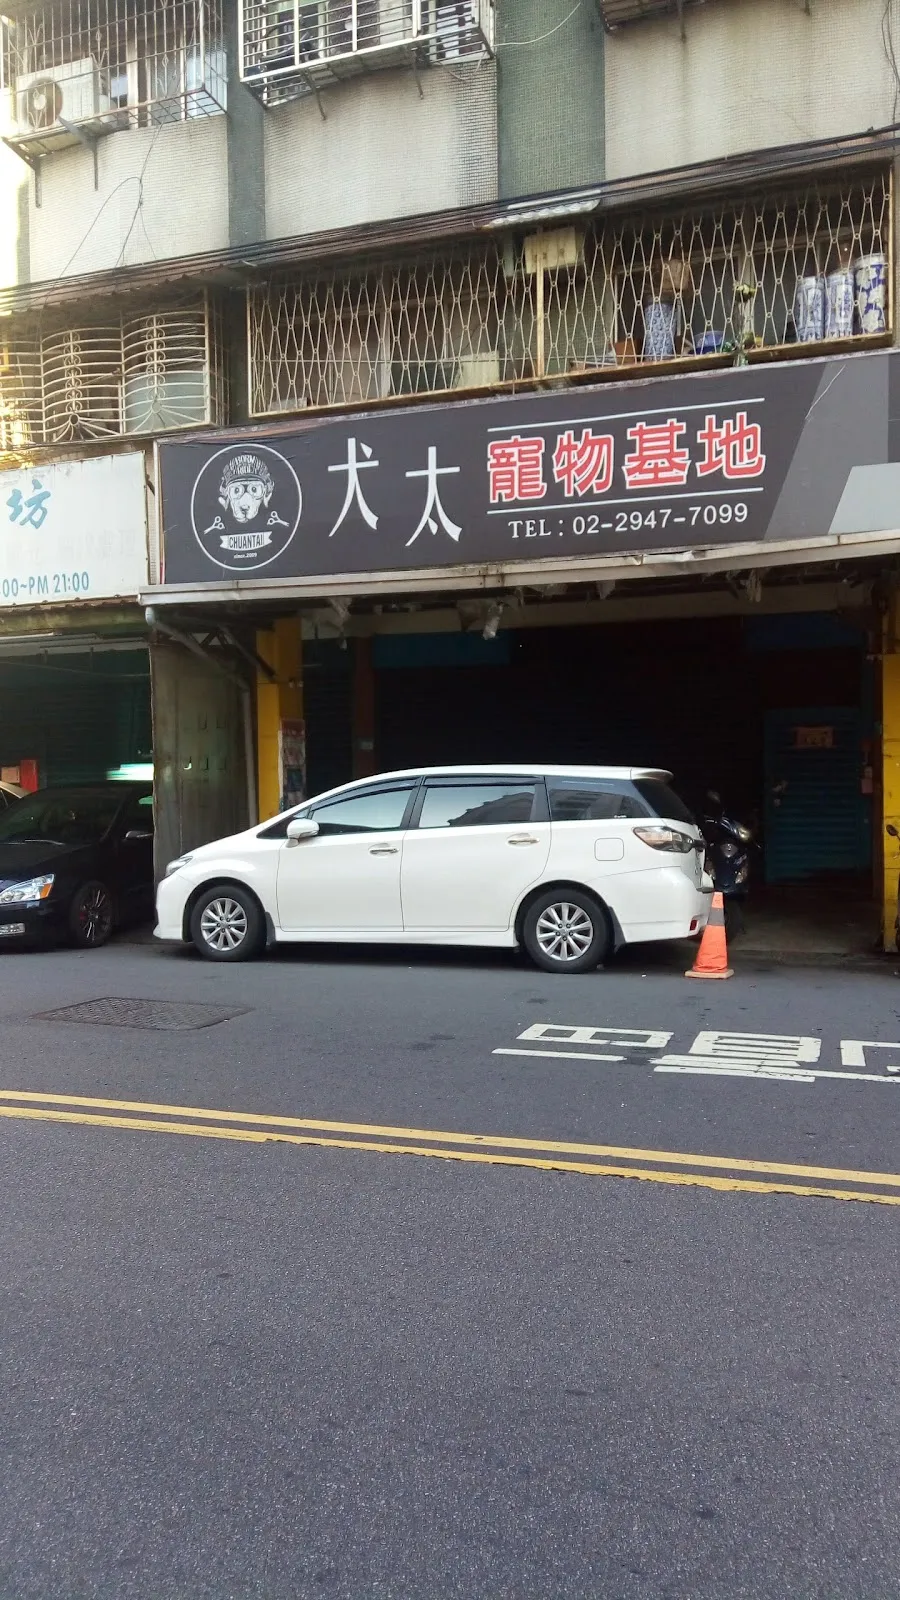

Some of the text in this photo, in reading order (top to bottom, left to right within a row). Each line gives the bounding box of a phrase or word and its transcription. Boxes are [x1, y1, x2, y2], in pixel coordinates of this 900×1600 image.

[487, 411, 766, 504] 寵物基地
[6, 478, 52, 530] 坊
[327, 437, 463, 547] 犬太
[572, 502, 749, 536] 02-2947-7099
[229, 534, 263, 550] CHUANTAI
[53, 571, 90, 594] 21:00
